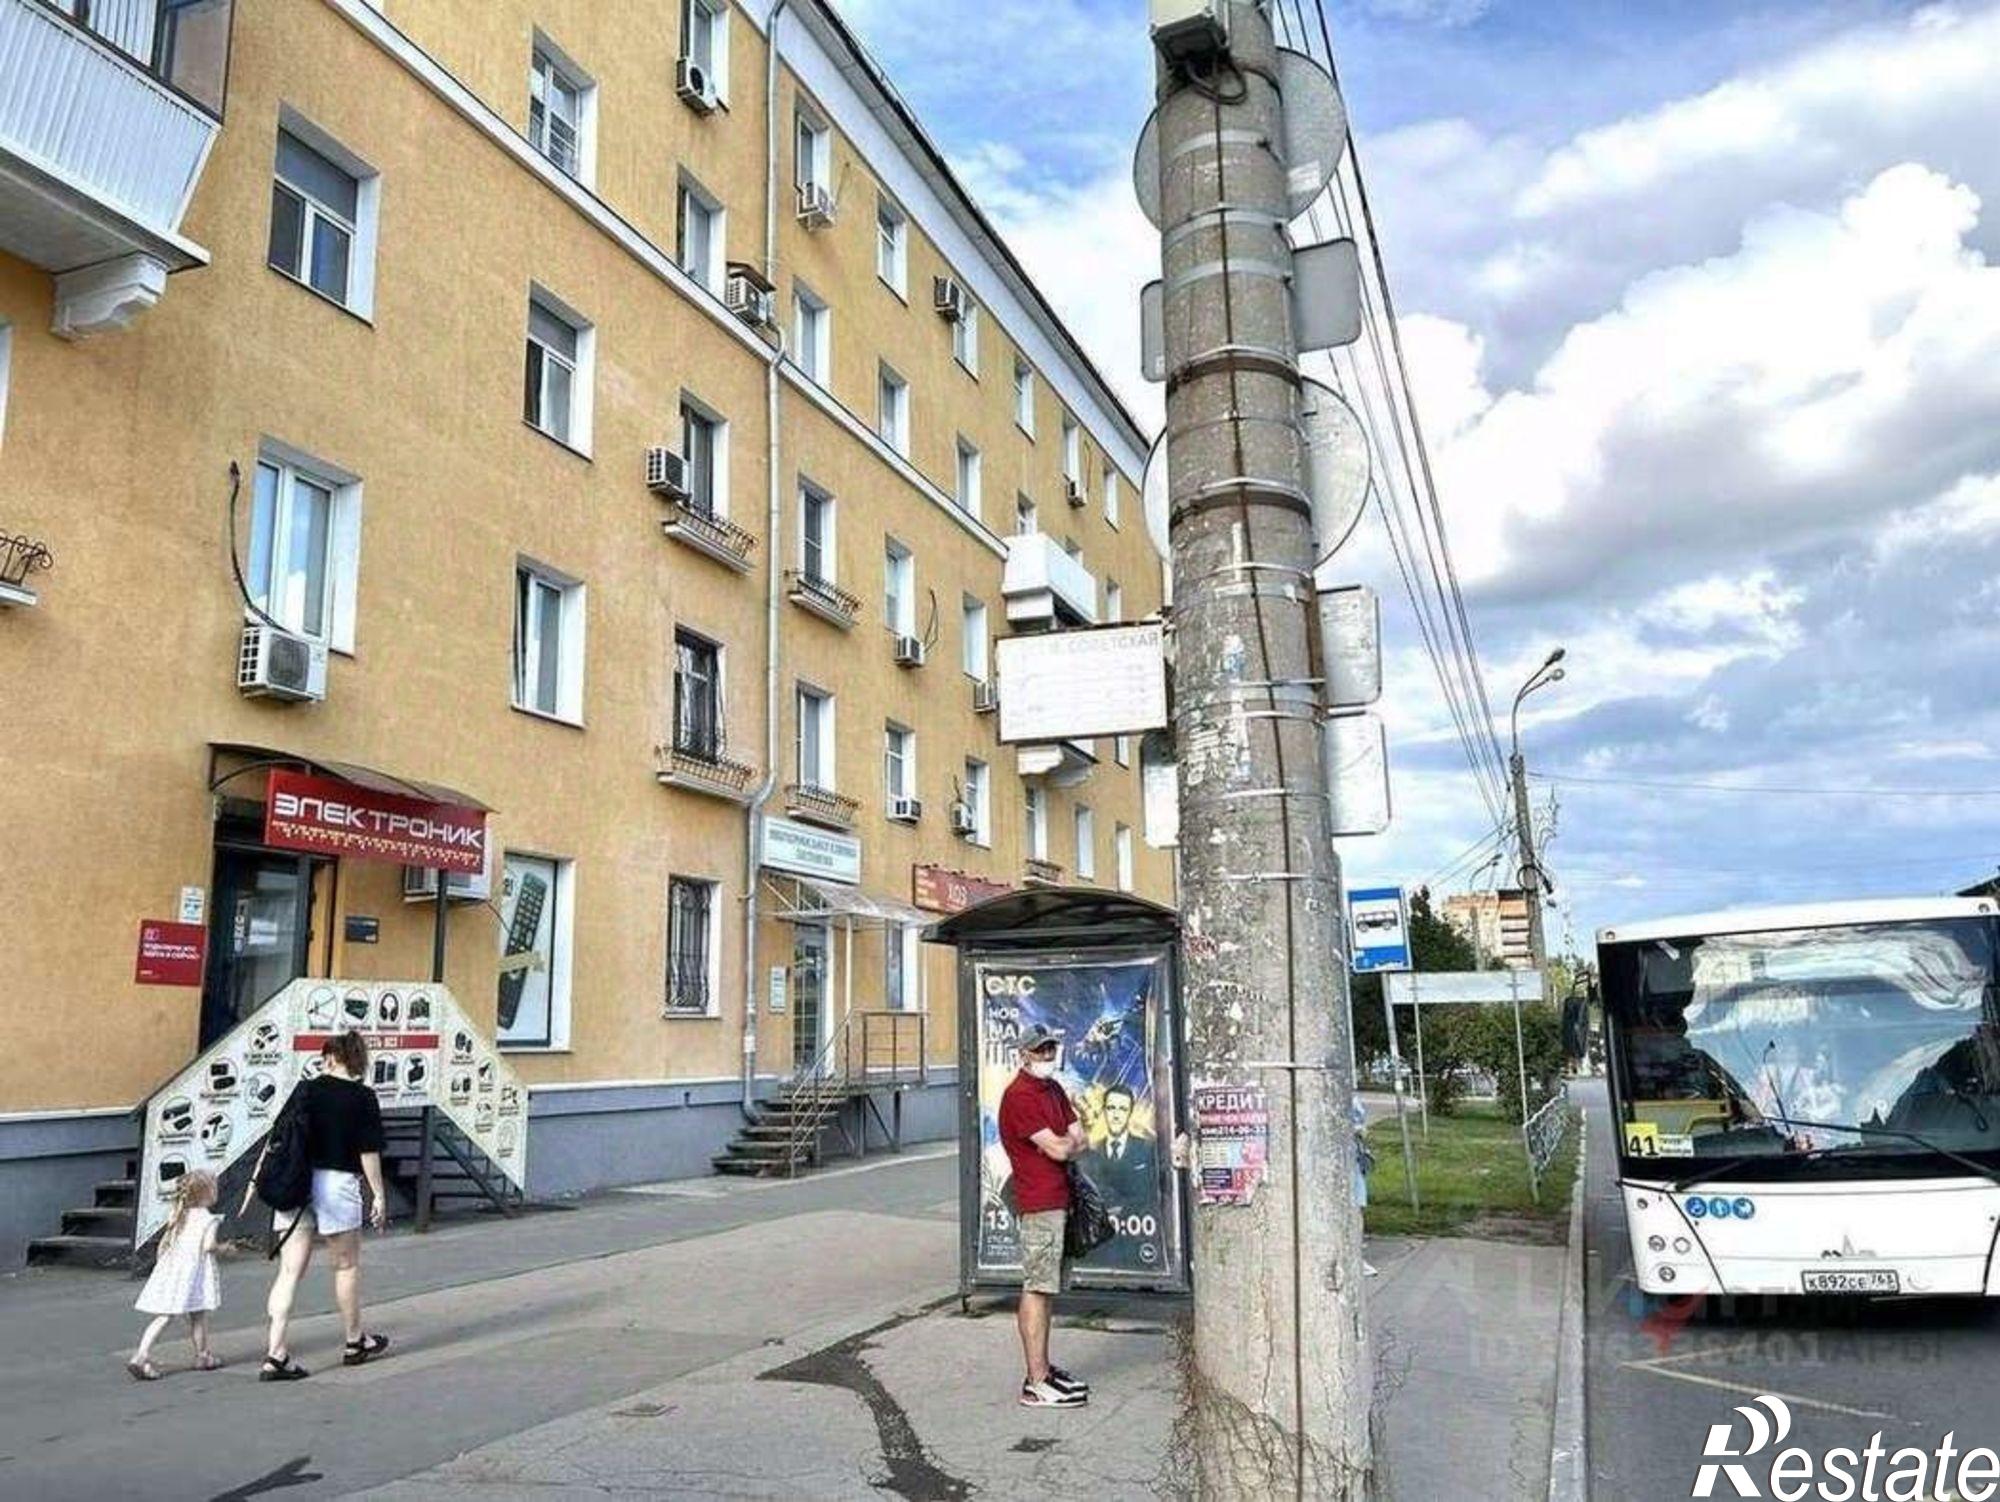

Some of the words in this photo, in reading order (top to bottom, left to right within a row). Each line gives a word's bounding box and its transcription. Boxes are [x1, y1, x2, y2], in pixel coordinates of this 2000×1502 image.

[274, 792, 483, 849] ЭЛЕКТРОНИК
[1199, 1093, 1266, 1112] КРЕДИТ
[1629, 1135, 1659, 1156] 41
[988, 1211, 1009, 1230] 13
